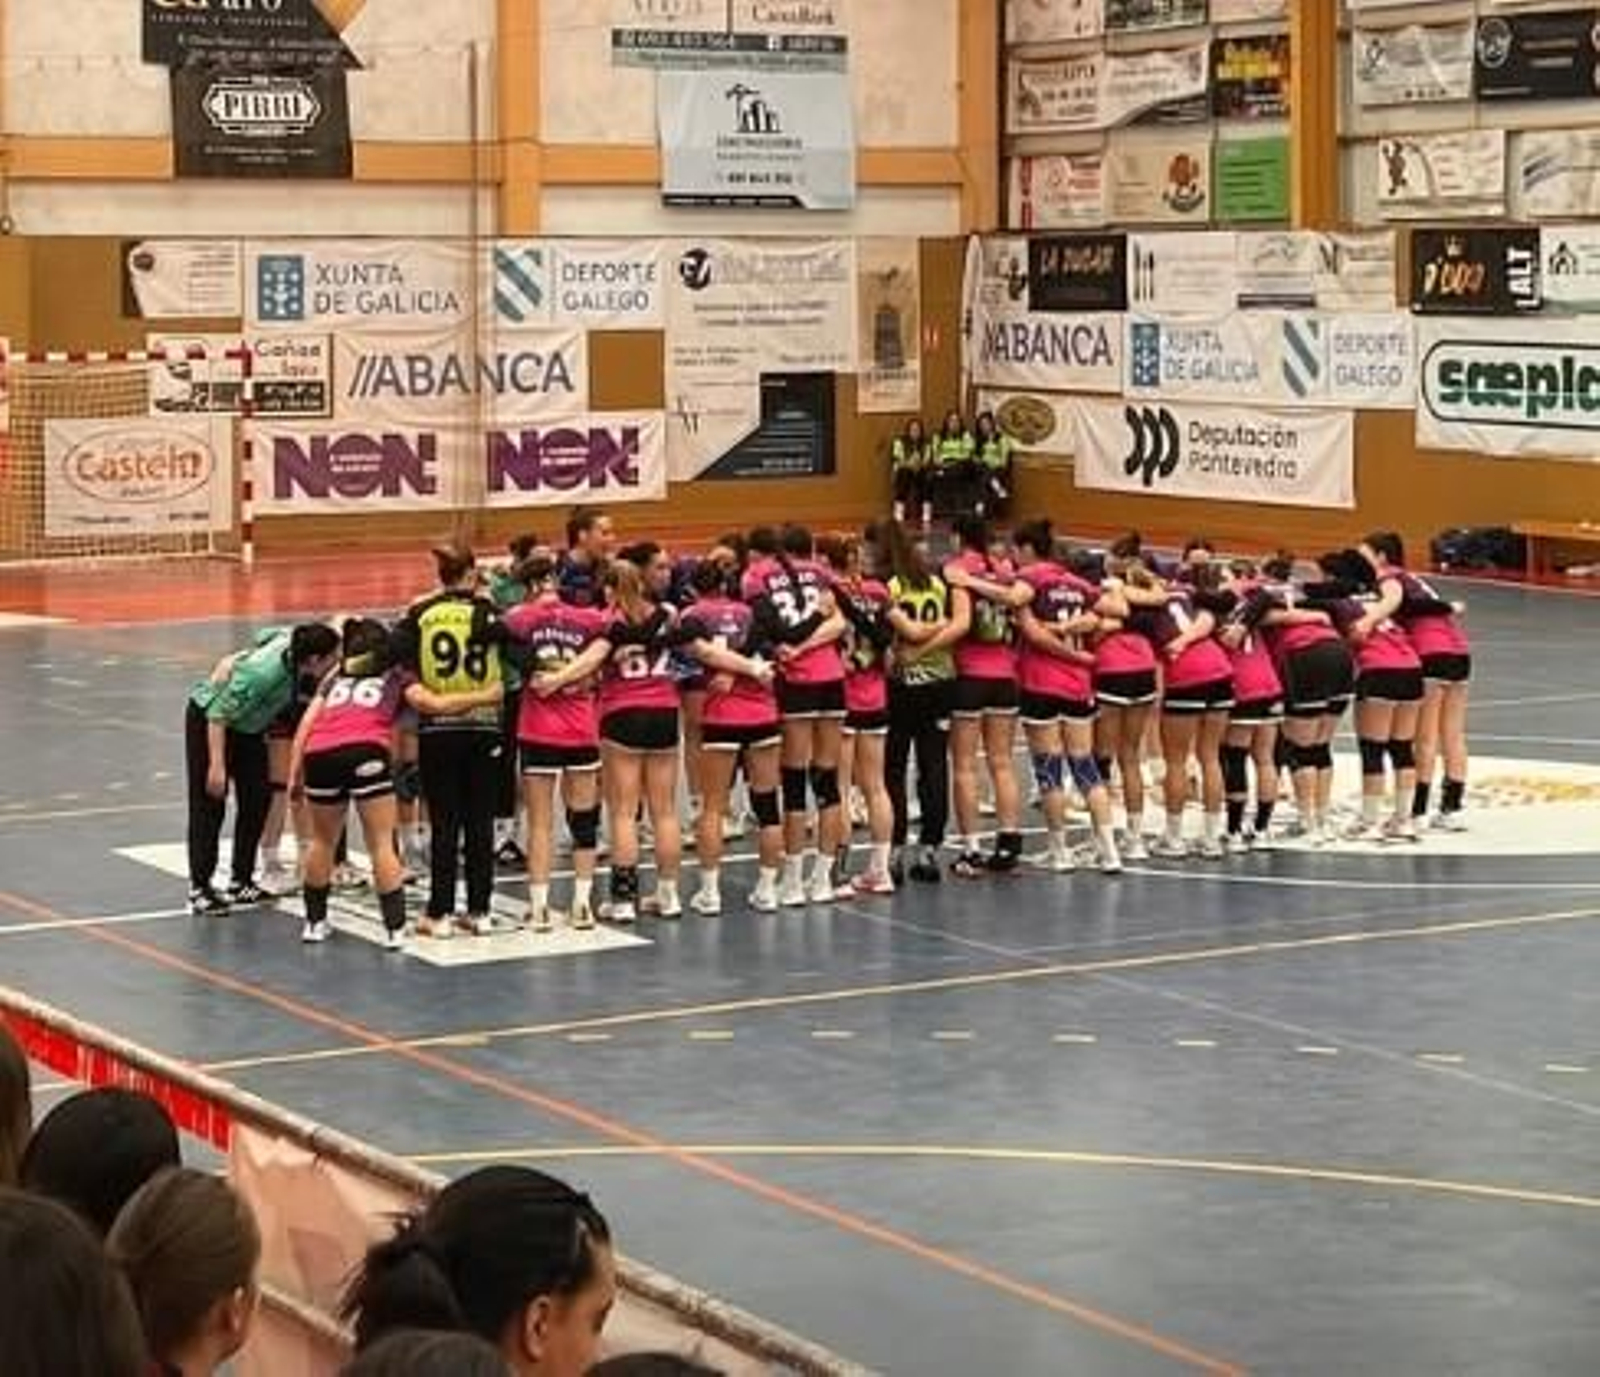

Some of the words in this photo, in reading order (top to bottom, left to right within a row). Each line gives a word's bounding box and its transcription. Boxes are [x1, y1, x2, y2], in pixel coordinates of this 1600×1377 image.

[315, 263, 403, 285] XUNTA
[562, 262, 656, 284] DEPORTE
[314, 290, 347, 314] DE
[356, 289, 461, 314] GALICIA
[562, 290, 649, 311] GALEGO
[1163, 329, 1222, 352] XUNTA
[1335, 333, 1407, 355] DEPORTE
[1165, 358, 1187, 380] DE
[1191, 359, 1258, 383] GALICIA
[1336, 365, 1403, 386] GALEGO
[1189, 451, 1297, 478] Pontevedra
[431, 631, 488, 681] 98
[325, 677, 384, 707] 66
